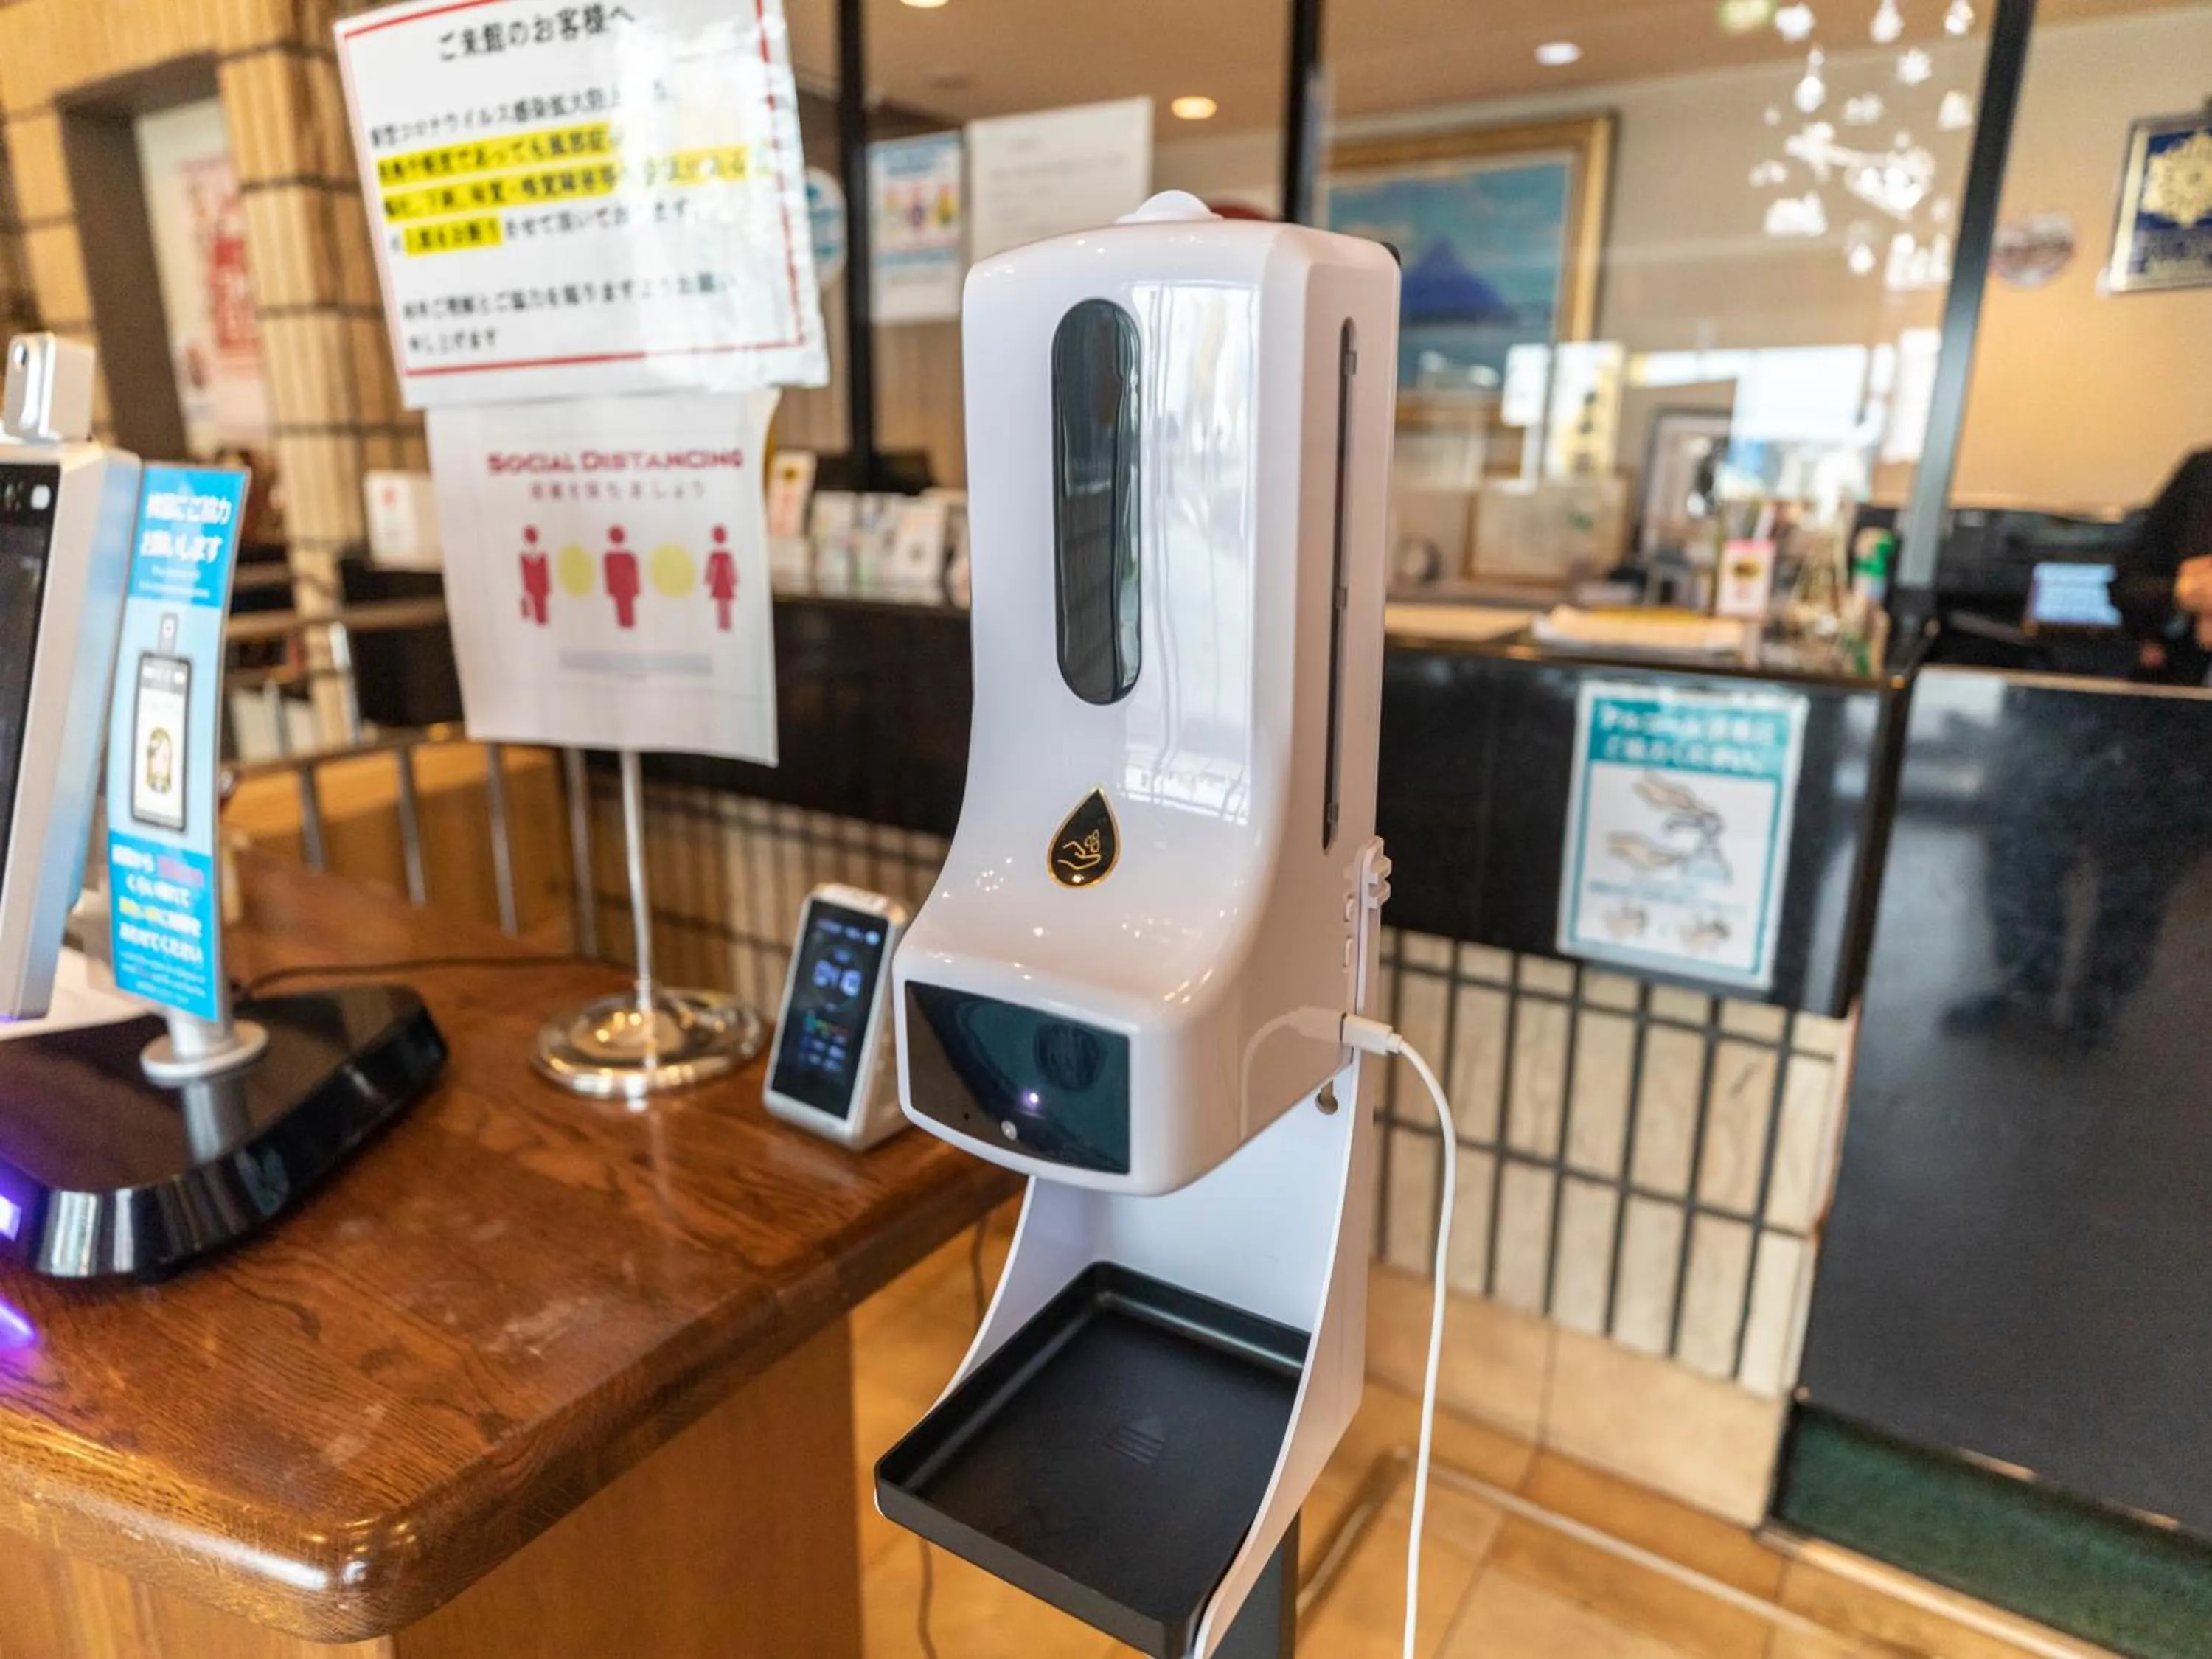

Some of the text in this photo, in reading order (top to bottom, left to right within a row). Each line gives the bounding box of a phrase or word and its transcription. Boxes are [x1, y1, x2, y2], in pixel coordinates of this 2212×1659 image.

[439, 3, 634, 62] ご来館のお客様へ
[489, 447, 743, 474] SOCIAL DISTANCING
